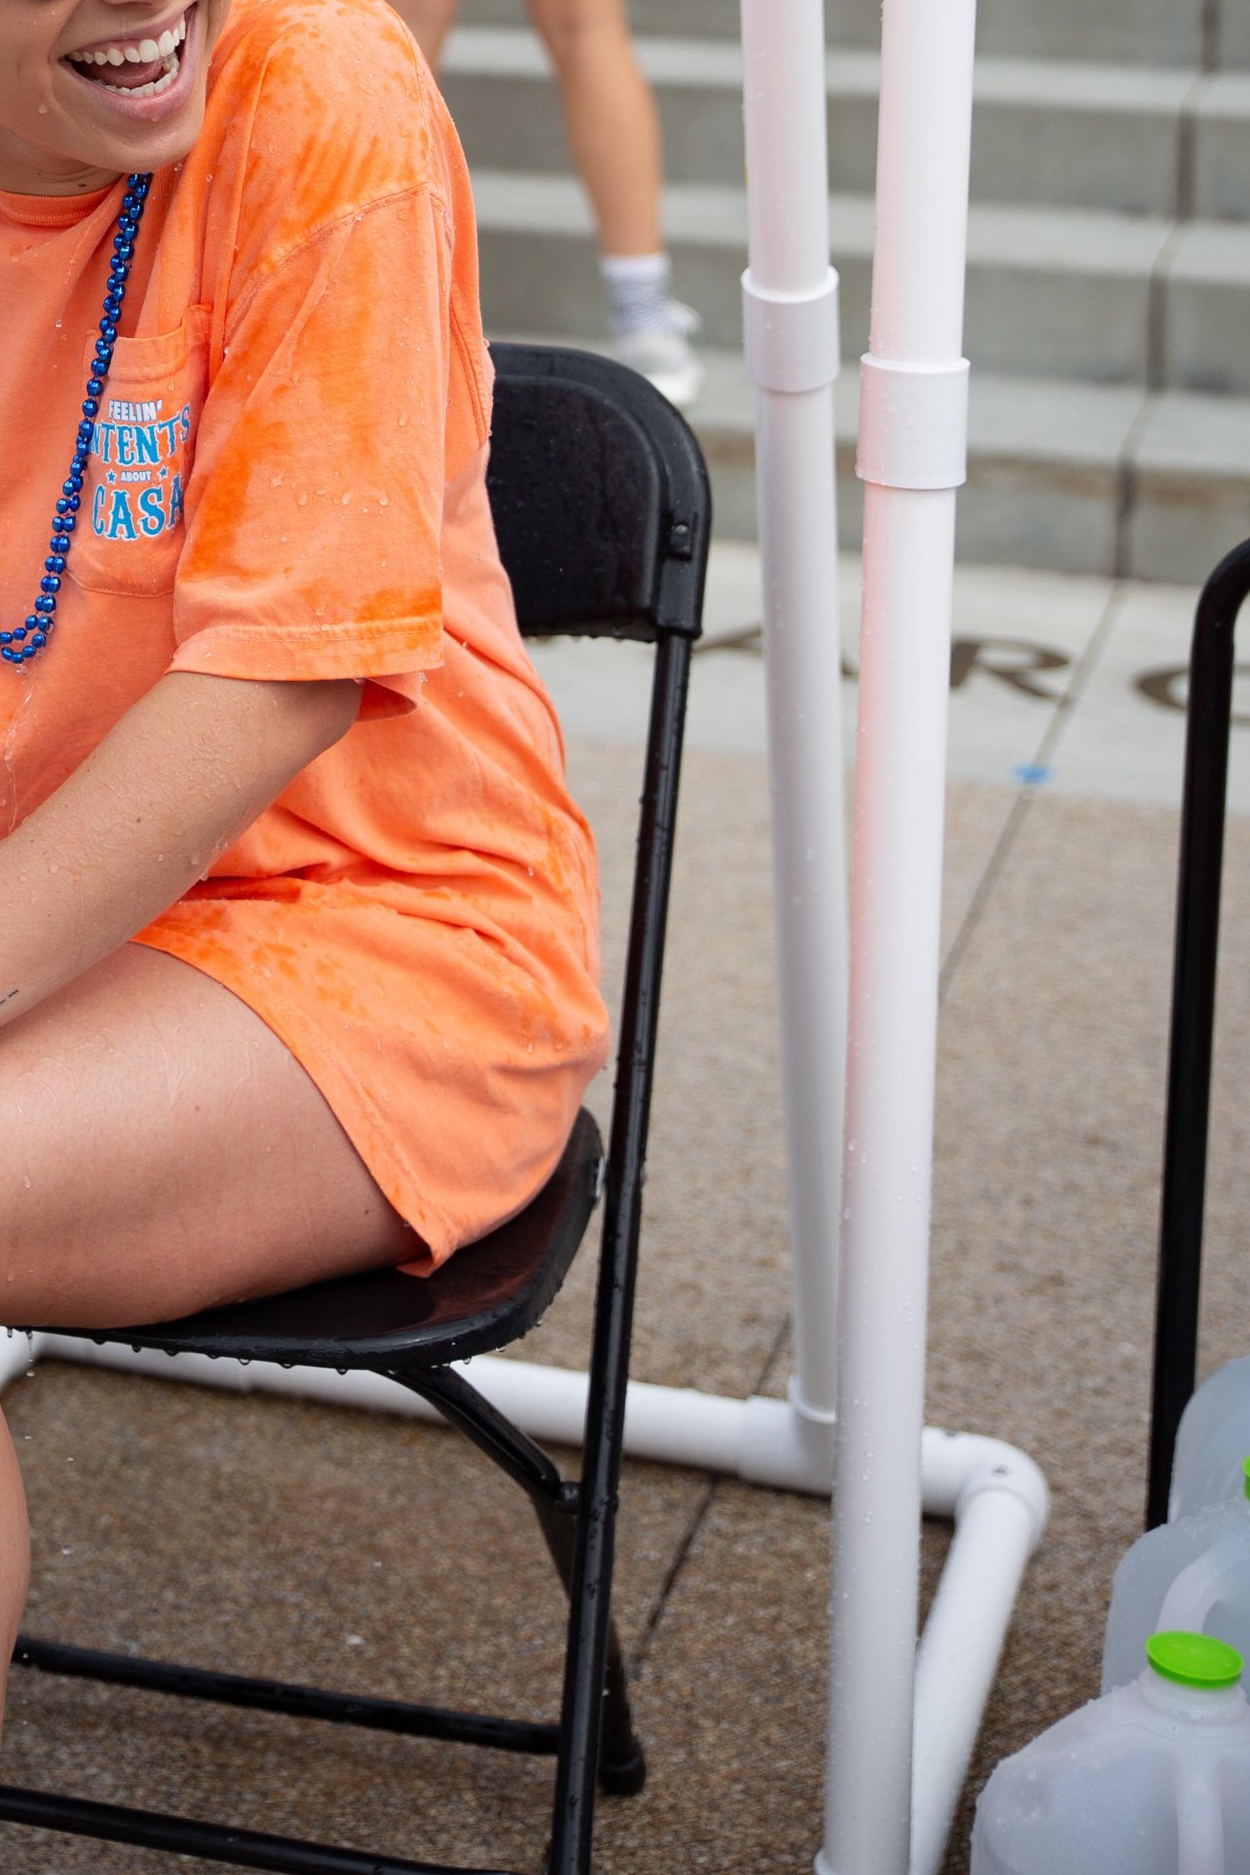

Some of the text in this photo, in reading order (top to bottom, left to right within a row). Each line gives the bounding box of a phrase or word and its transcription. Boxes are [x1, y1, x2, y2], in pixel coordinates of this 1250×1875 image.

[108, 399, 163, 422] FEELIN'
[89, 402, 191, 466] NTENTS
[120, 471, 151, 483] ABOUT
[92, 472, 184, 541] CASA
